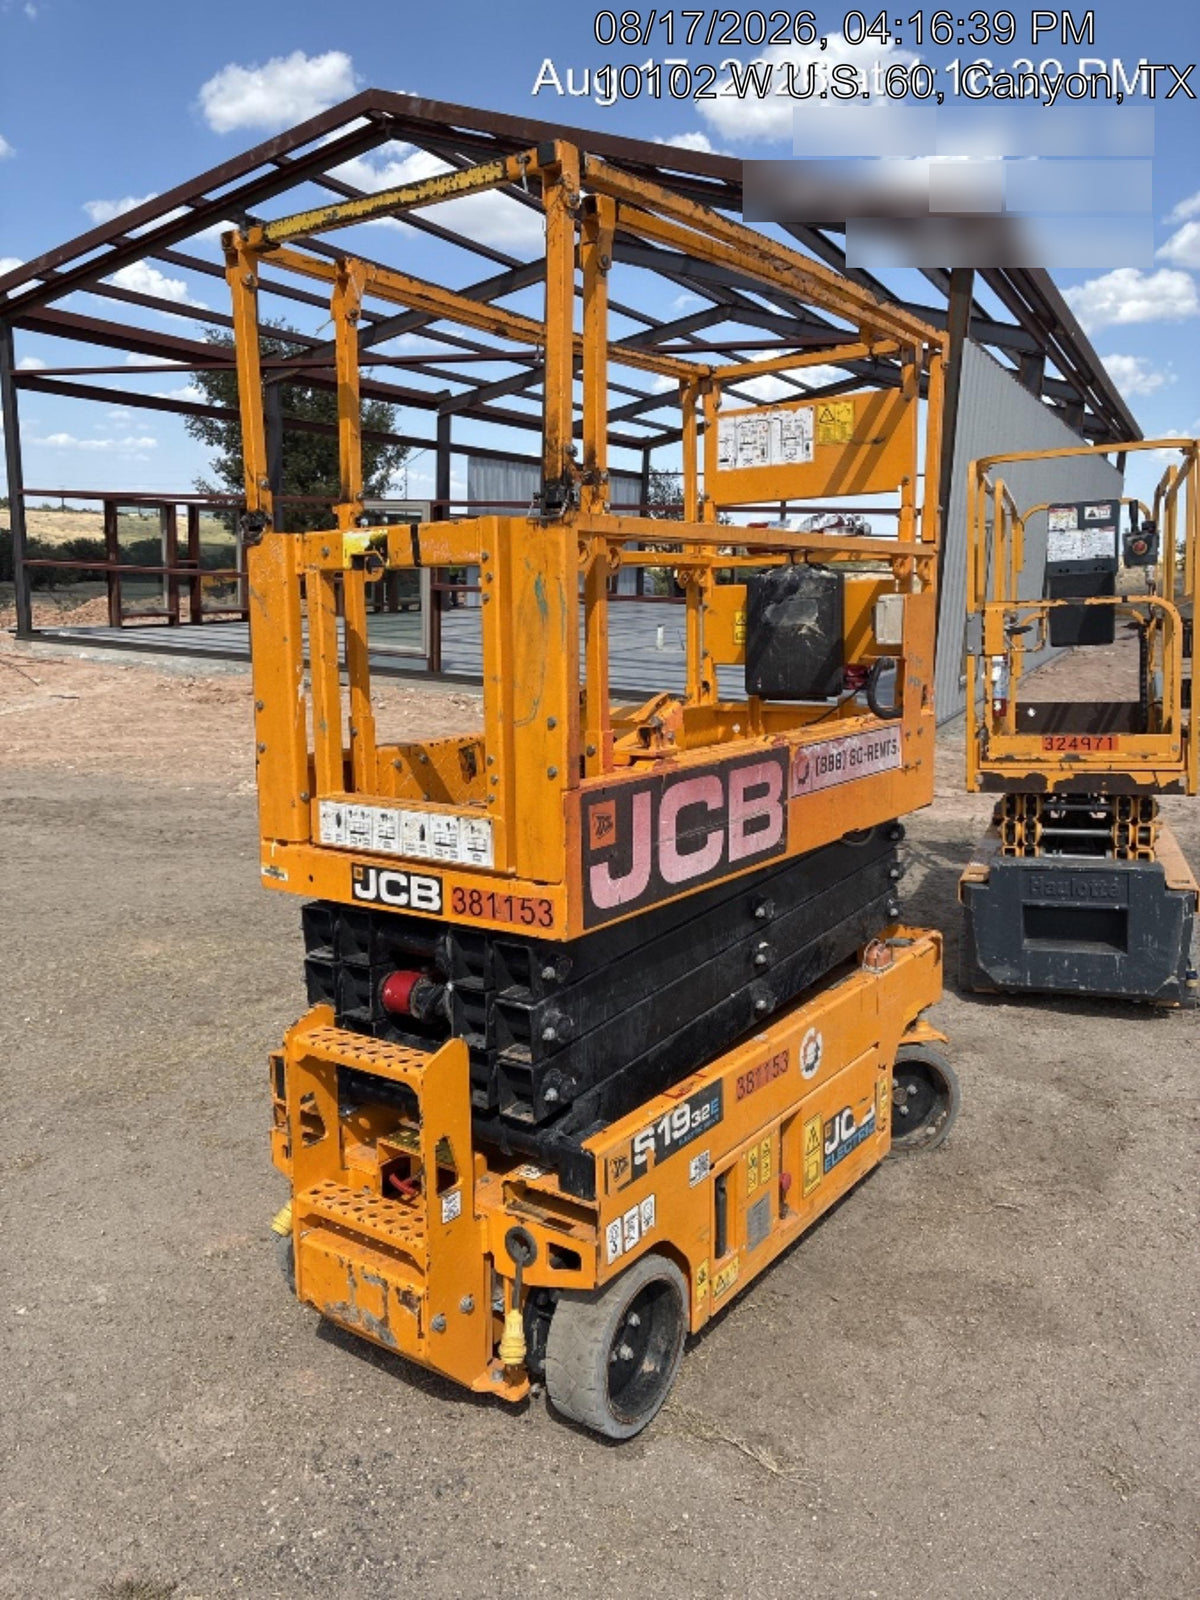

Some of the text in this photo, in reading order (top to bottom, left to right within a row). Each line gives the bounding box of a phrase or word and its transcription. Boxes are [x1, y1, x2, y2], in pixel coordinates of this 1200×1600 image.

[1044, 736, 1113, 751] 324971
[589, 760, 784, 909] JCB
[354, 868, 442, 912] JCB
[452, 886, 554, 927] 381153
[736, 1050, 789, 1100] 381153
